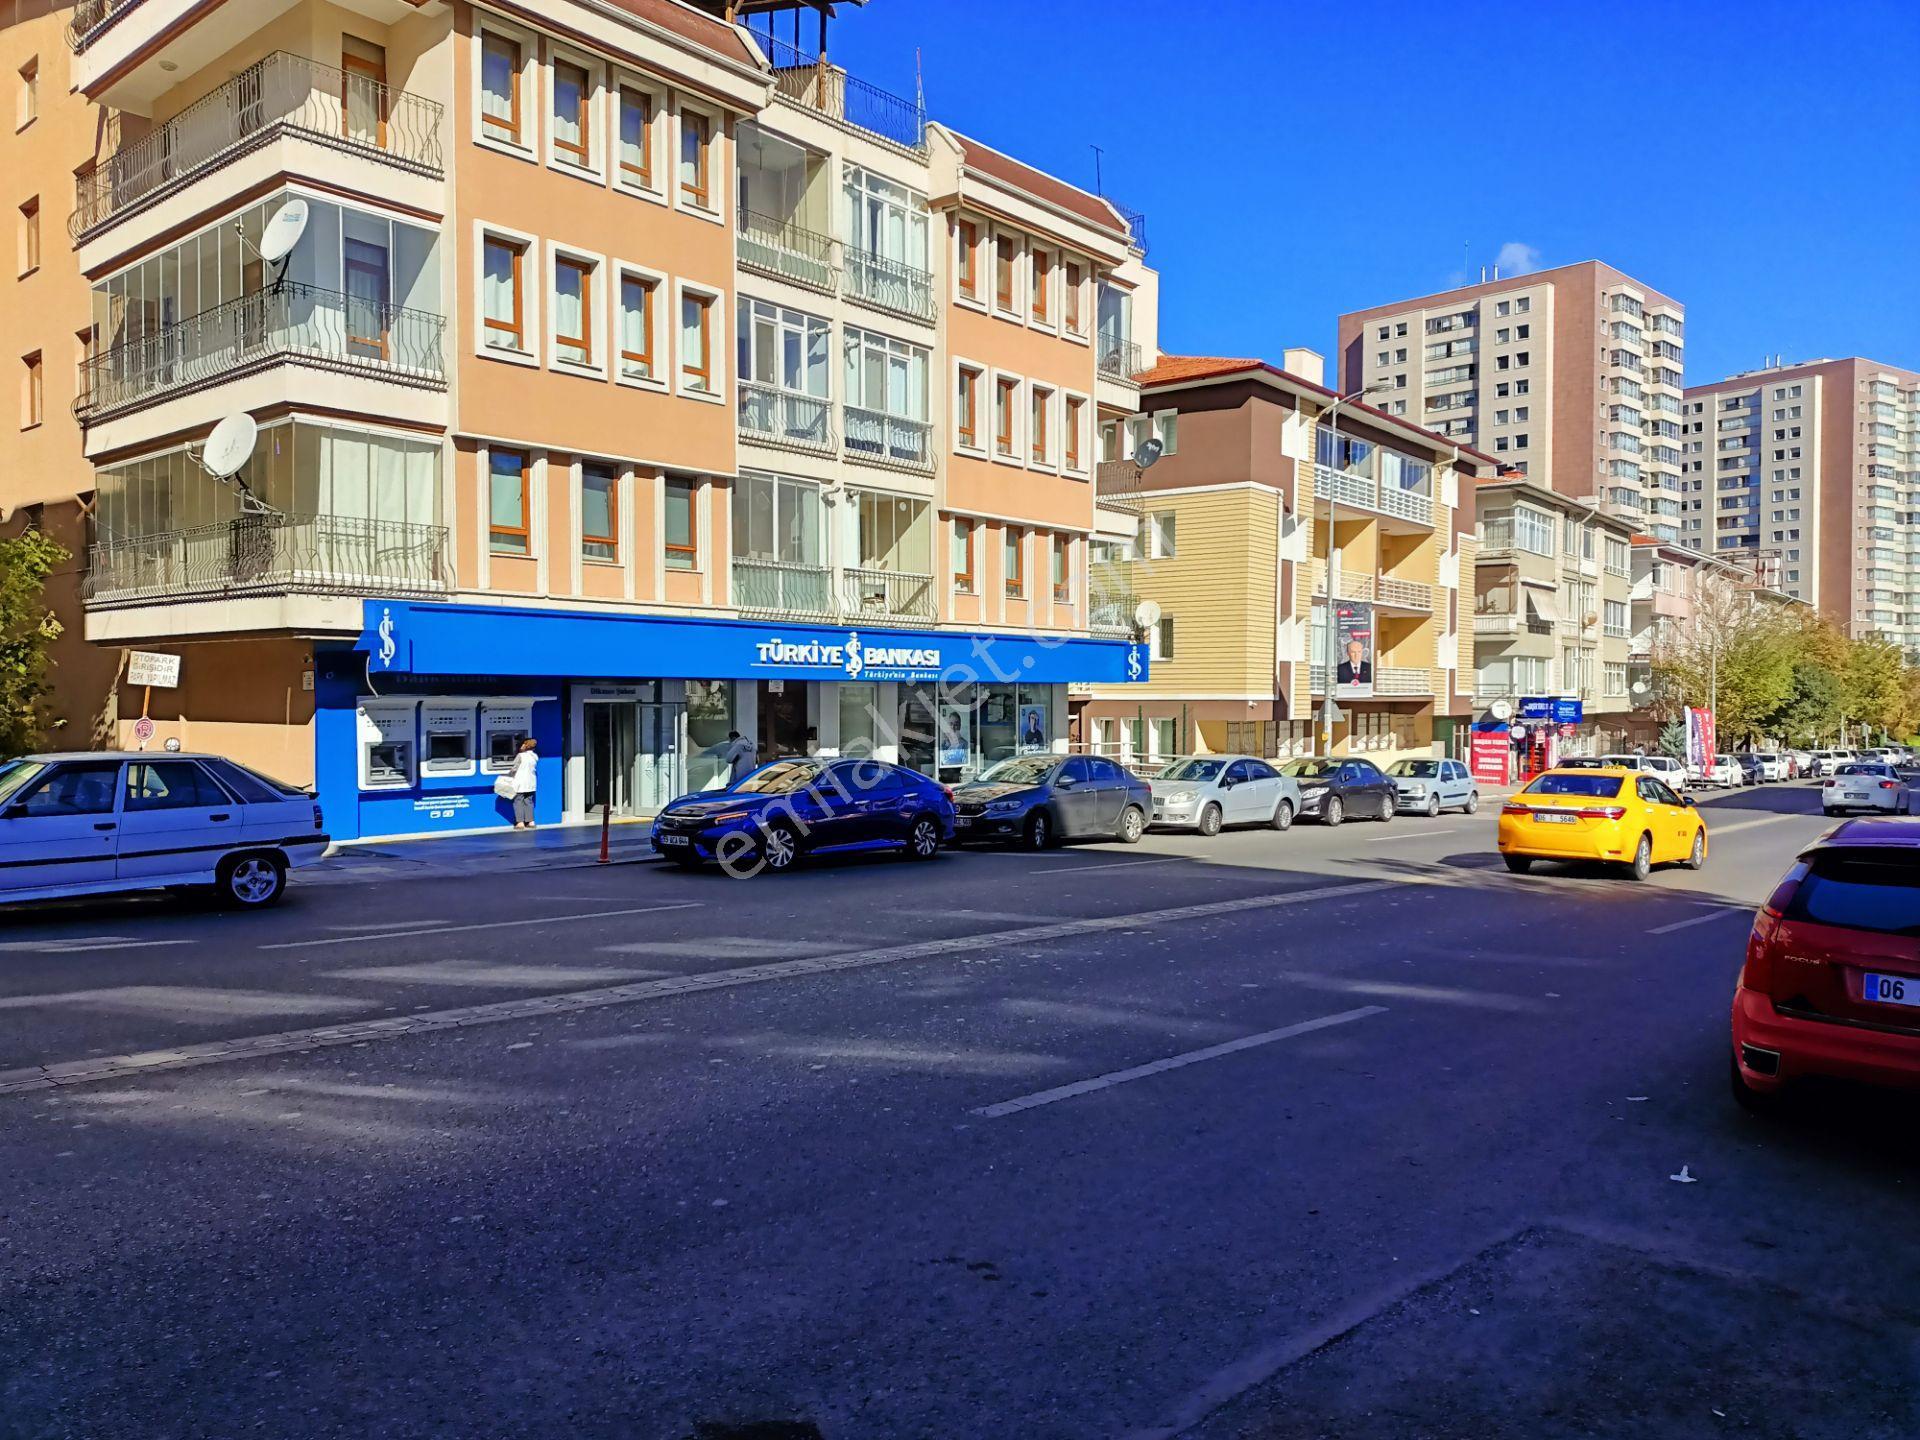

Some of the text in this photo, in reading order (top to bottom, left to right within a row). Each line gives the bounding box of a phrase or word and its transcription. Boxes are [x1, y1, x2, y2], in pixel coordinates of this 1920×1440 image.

[756, 638, 843, 664] TÜRKİYE
[864, 647, 940, 666] BANKASI
[1784, 955, 1820, 965] FOCUS
[1879, 978, 1905, 1001] 06
